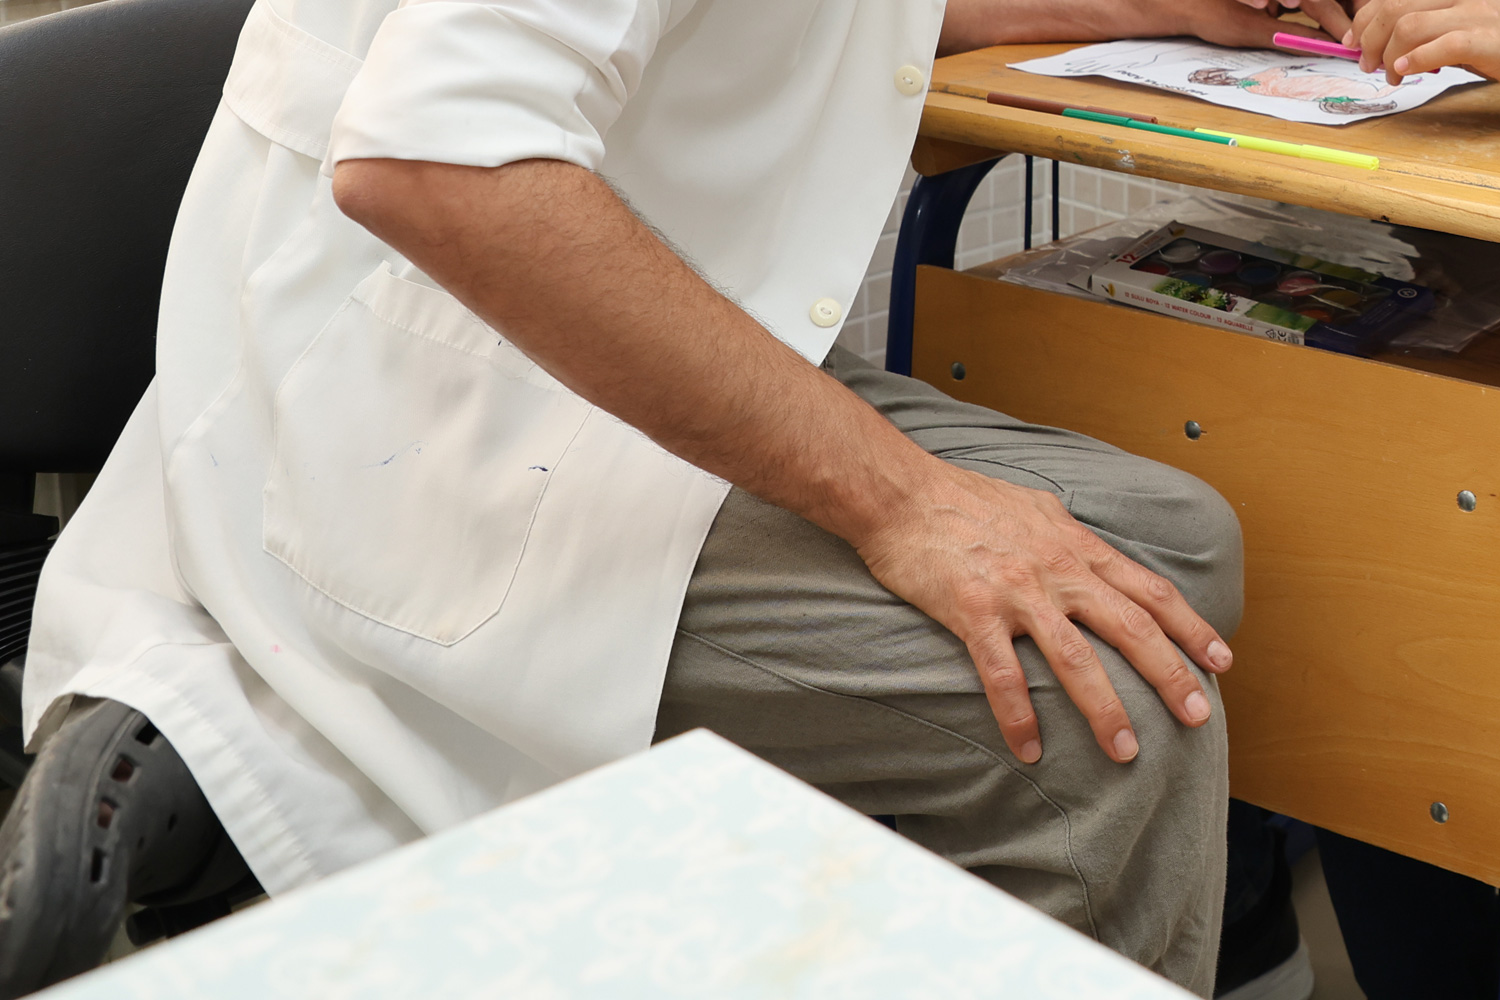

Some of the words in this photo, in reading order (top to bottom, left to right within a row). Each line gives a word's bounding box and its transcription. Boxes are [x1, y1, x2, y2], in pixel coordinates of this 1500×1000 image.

[1131, 293, 1145, 302] SULU
[1145, 297, 1160, 306] BOYA
[1171, 304, 1188, 314] WATER
[1189, 309, 1212, 320] COLOUR
[1224, 319, 1254, 332] AQUARELLE
